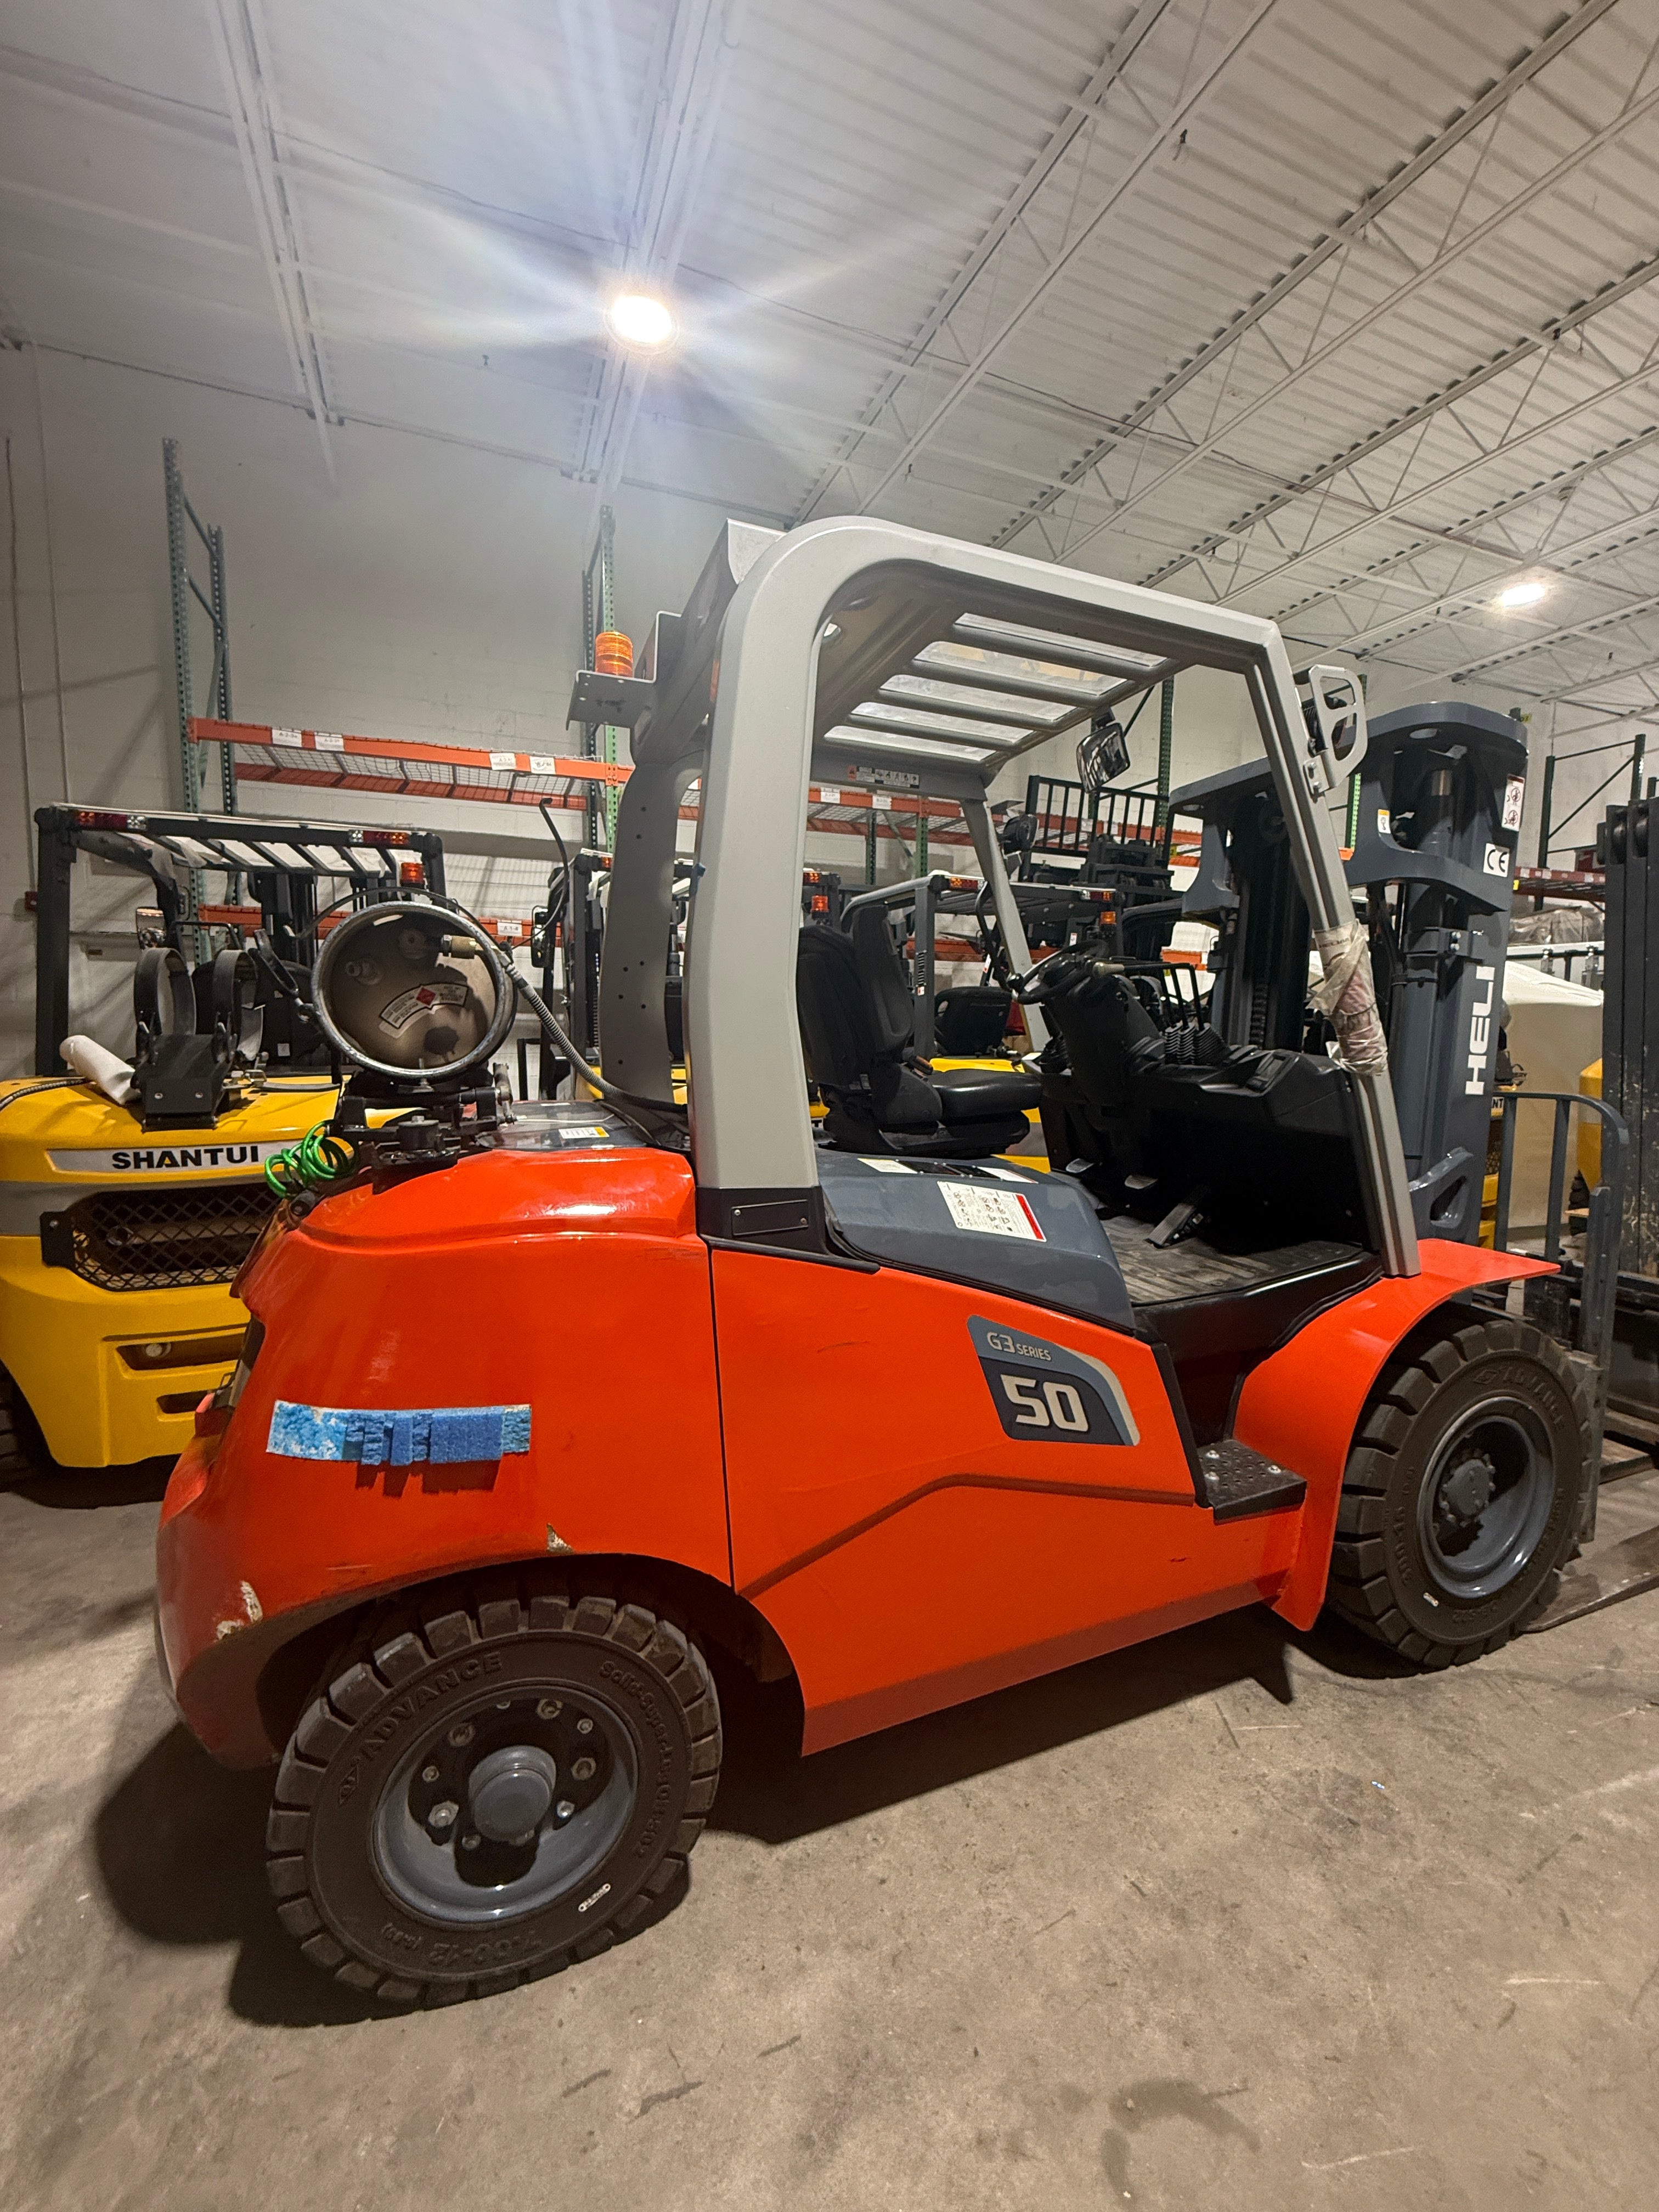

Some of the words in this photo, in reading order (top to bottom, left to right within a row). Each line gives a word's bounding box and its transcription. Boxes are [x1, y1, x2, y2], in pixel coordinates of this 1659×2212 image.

[1487, 849, 1508, 873] CE
[1465, 966, 1495, 1095] HELI
[112, 1146, 259, 1169] SHANTUI
[987, 1331, 1015, 1353] G3
[1017, 1344, 1052, 1361] SERIES
[1000, 1374, 1088, 1432] 50
[358, 1651, 503, 1761] ADVANCE
